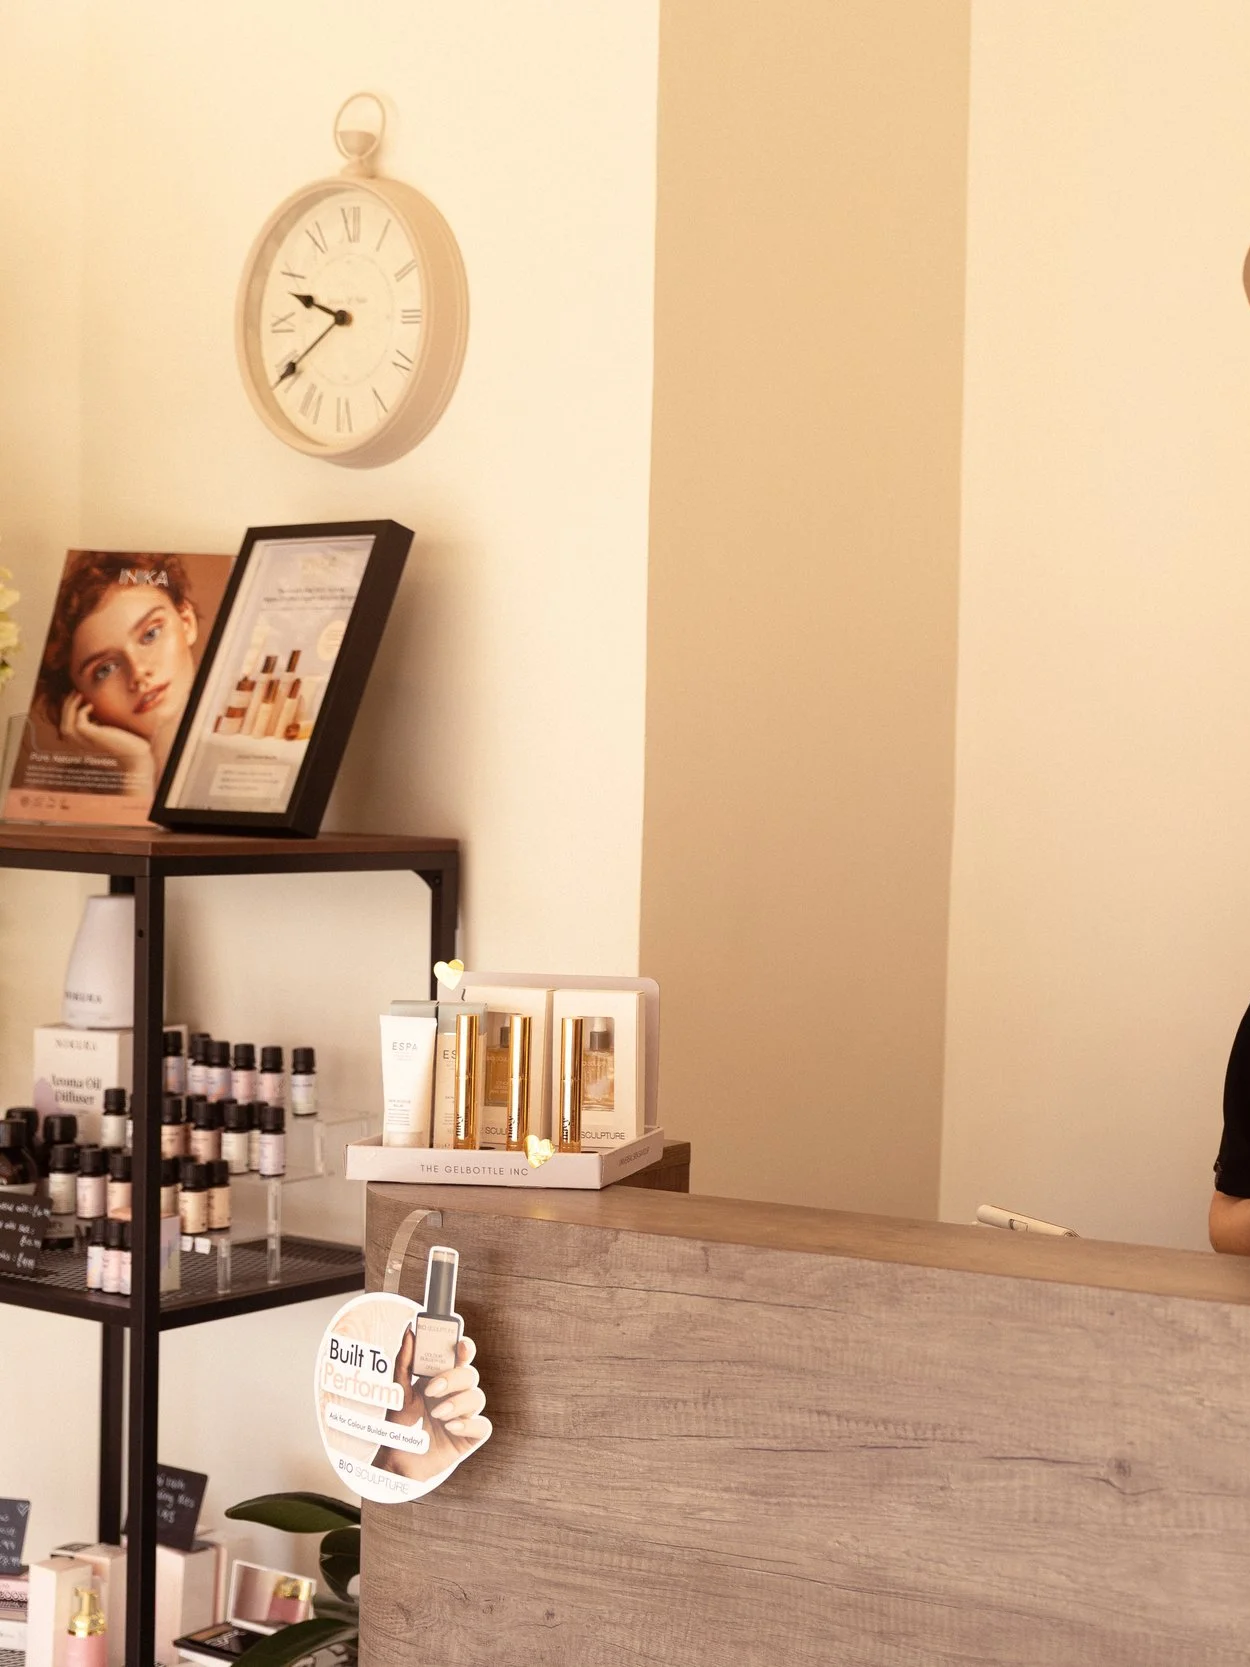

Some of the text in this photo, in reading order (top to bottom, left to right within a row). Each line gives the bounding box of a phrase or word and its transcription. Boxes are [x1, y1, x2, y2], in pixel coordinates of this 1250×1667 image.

[392, 1041, 418, 1051] ESPA
[581, 1130, 625, 1140] SCULPTURE
[421, 1164, 529, 1177] THE GELBOTTLE INC
[329, 1338, 388, 1374] Built To
[324, 1362, 400, 1405] Perform
[329, 1412, 338, 1421] Ask
[347, 1418, 366, 1431] Colour
[367, 1424, 388, 1437] Builder
[389, 1432, 401, 1441] Gel
[402, 1435, 424, 1447] today!
[338, 1459, 409, 1496] BIO SCULPTURE
